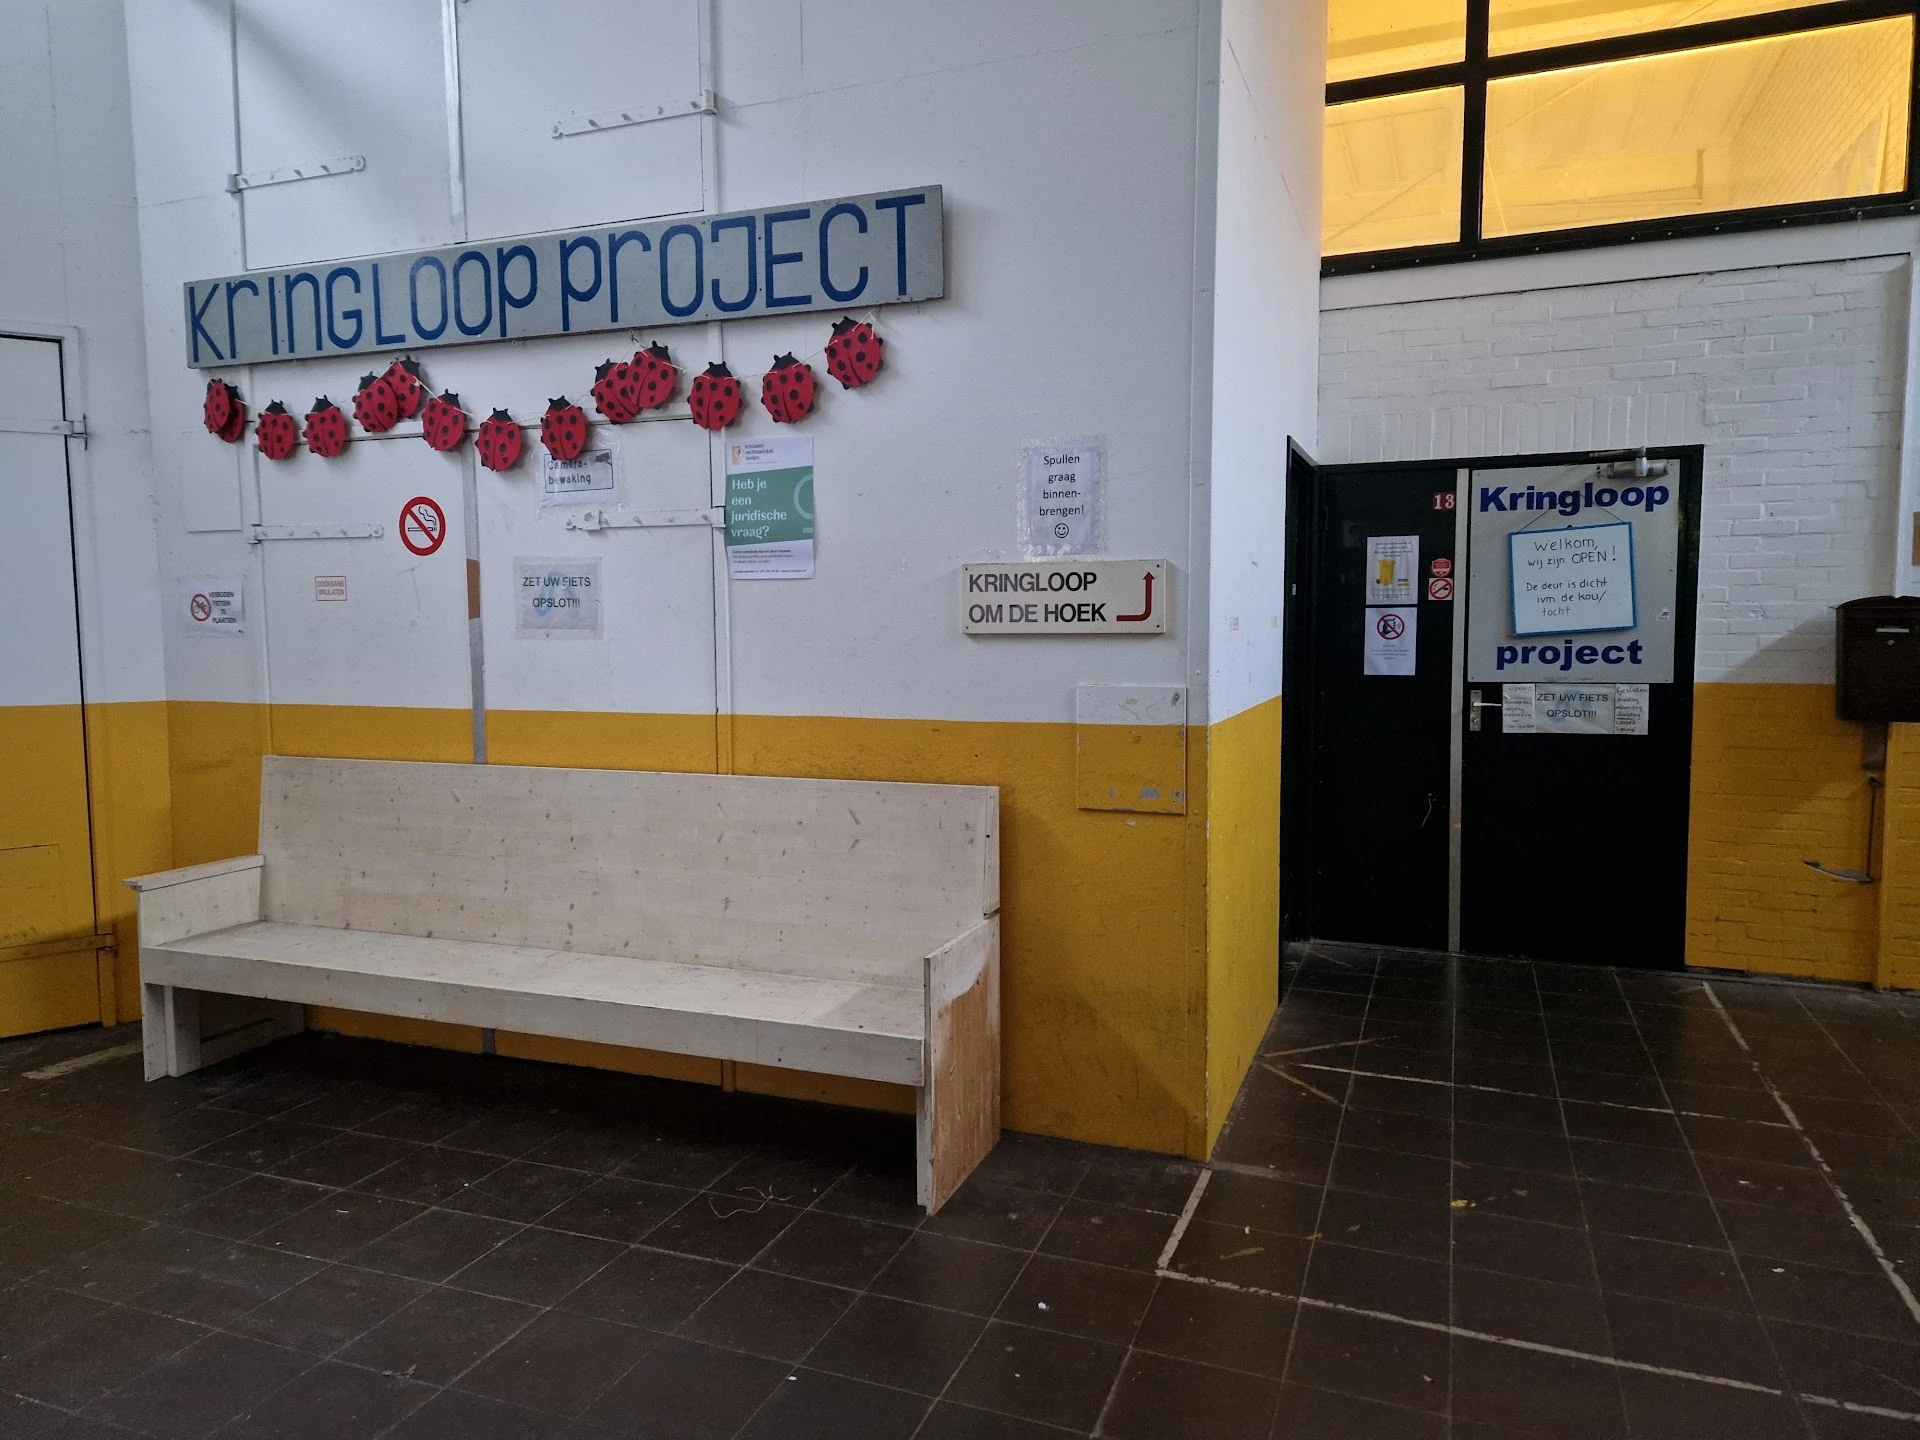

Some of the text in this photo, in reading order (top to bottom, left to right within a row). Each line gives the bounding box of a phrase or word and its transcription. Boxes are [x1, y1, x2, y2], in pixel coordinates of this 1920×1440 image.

[1043, 454, 1080, 467] Spullen
[549, 473, 591, 485] bewaking
[732, 478, 767, 492] Heb je
[1048, 473, 1076, 485] graag
[731, 496, 752, 506] een
[1043, 489, 1082, 500] binnen-
[1480, 482, 1670, 516] Kringloop
[1434, 494, 1455, 510] 13
[731, 509, 787, 524] juridische
[1039, 505, 1085, 517] brengen!
[731, 525, 770, 539] vraag?
[1534, 538, 1598, 551] Welkom,
[1528, 557, 1543, 570] wij
[1547, 556, 1566, 569] zijn
[523, 577, 591, 587] ZET UW FIETS
[969, 571, 1097, 593] KRINGLOOP
[1526, 577, 1608, 591] De deur is dicht
[533, 597, 580, 608] OPSLOT!!!
[1537, 596, 1556, 604] ivm
[1562, 593, 1574, 602] de
[969, 602, 1107, 624] OM DE HOEK
[1543, 606, 1571, 617] tocht
[1496, 639, 1643, 672] project
[1537, 693, 1609, 702] ZET UW FIETS
[1547, 709, 1597, 717] OPSLOT!!!
